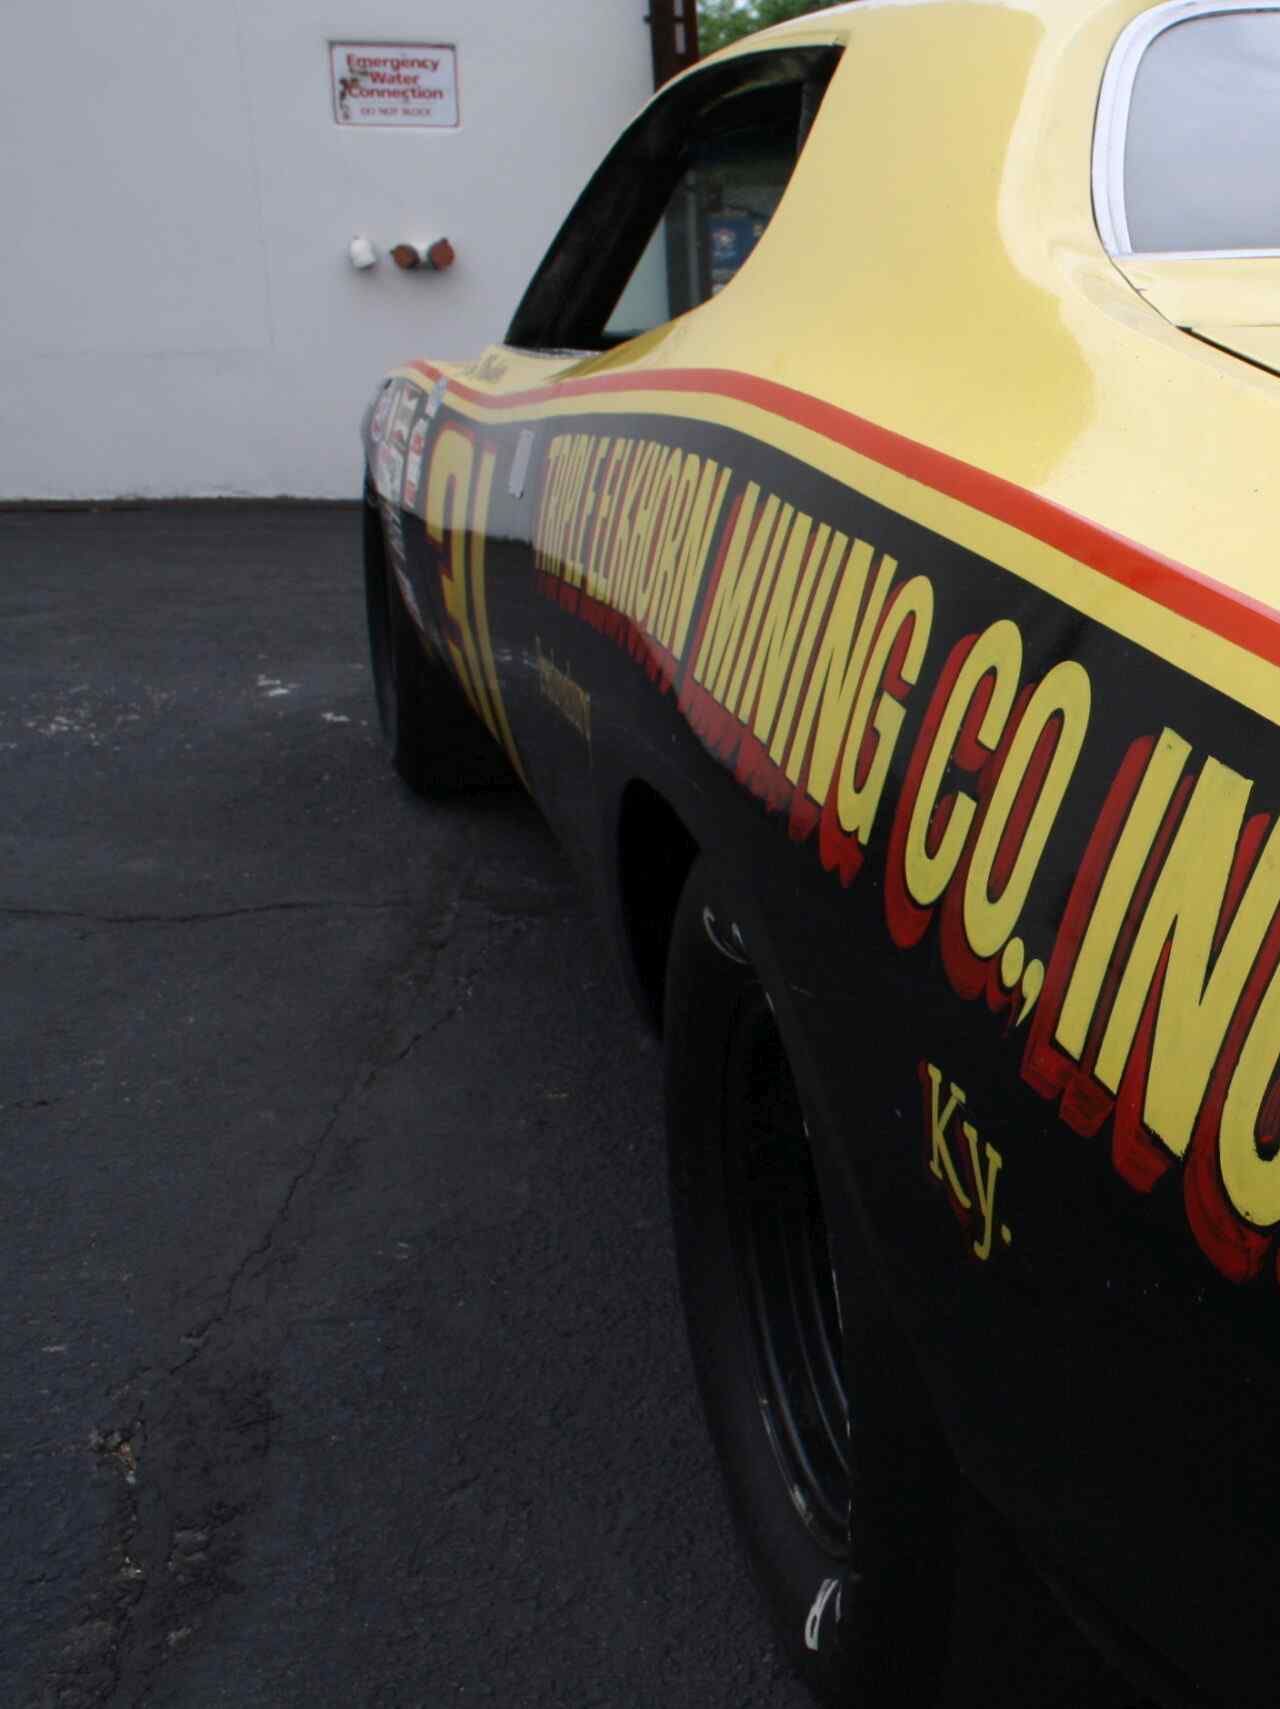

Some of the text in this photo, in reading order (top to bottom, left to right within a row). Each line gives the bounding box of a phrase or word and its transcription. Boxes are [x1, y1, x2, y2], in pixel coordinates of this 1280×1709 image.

[346, 53, 439, 73] Emergency
[369, 71, 418, 85] Water
[349, 86, 443, 101] Connection
[586, 438, 733, 660] ELKHORN
[693, 480, 935, 846] MINING
[926, 1062, 1012, 1260] Ky.
